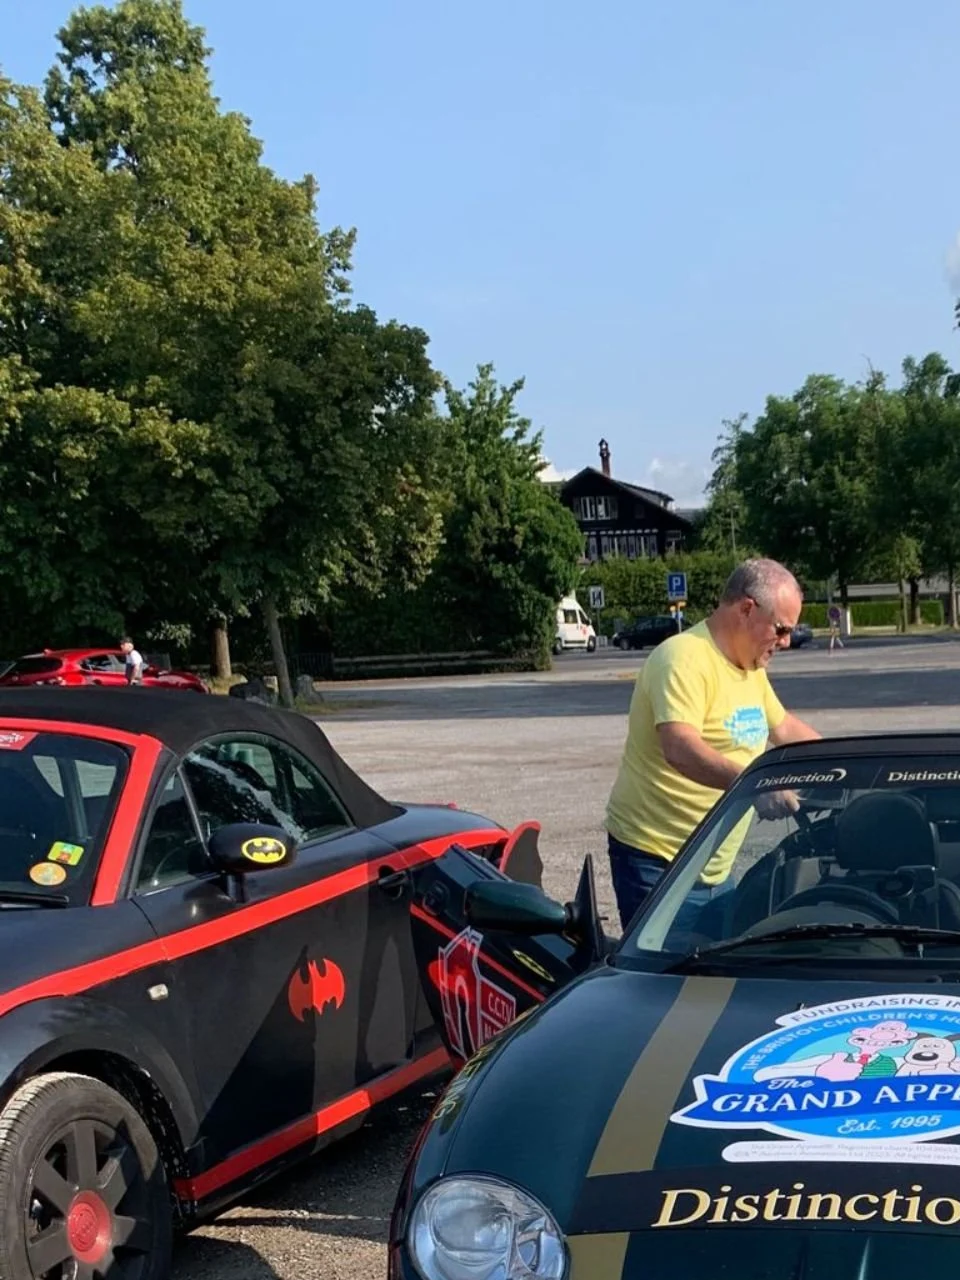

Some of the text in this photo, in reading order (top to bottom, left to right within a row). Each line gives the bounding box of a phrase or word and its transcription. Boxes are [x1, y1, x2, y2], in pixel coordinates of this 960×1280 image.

[672, 576, 681, 590] P
[755, 772, 836, 789] Distinction
[791, 997, 939, 1022] FUNDRAISING
[741, 1051, 766, 1071] THE
[761, 1025, 823, 1055] BRISTOL
[823, 1012, 936, 1029] CHILDREN'S
[768, 1078, 815, 1091] The
[711, 1089, 861, 1113] GRAND
[836, 1114, 944, 1135] Est. 1995
